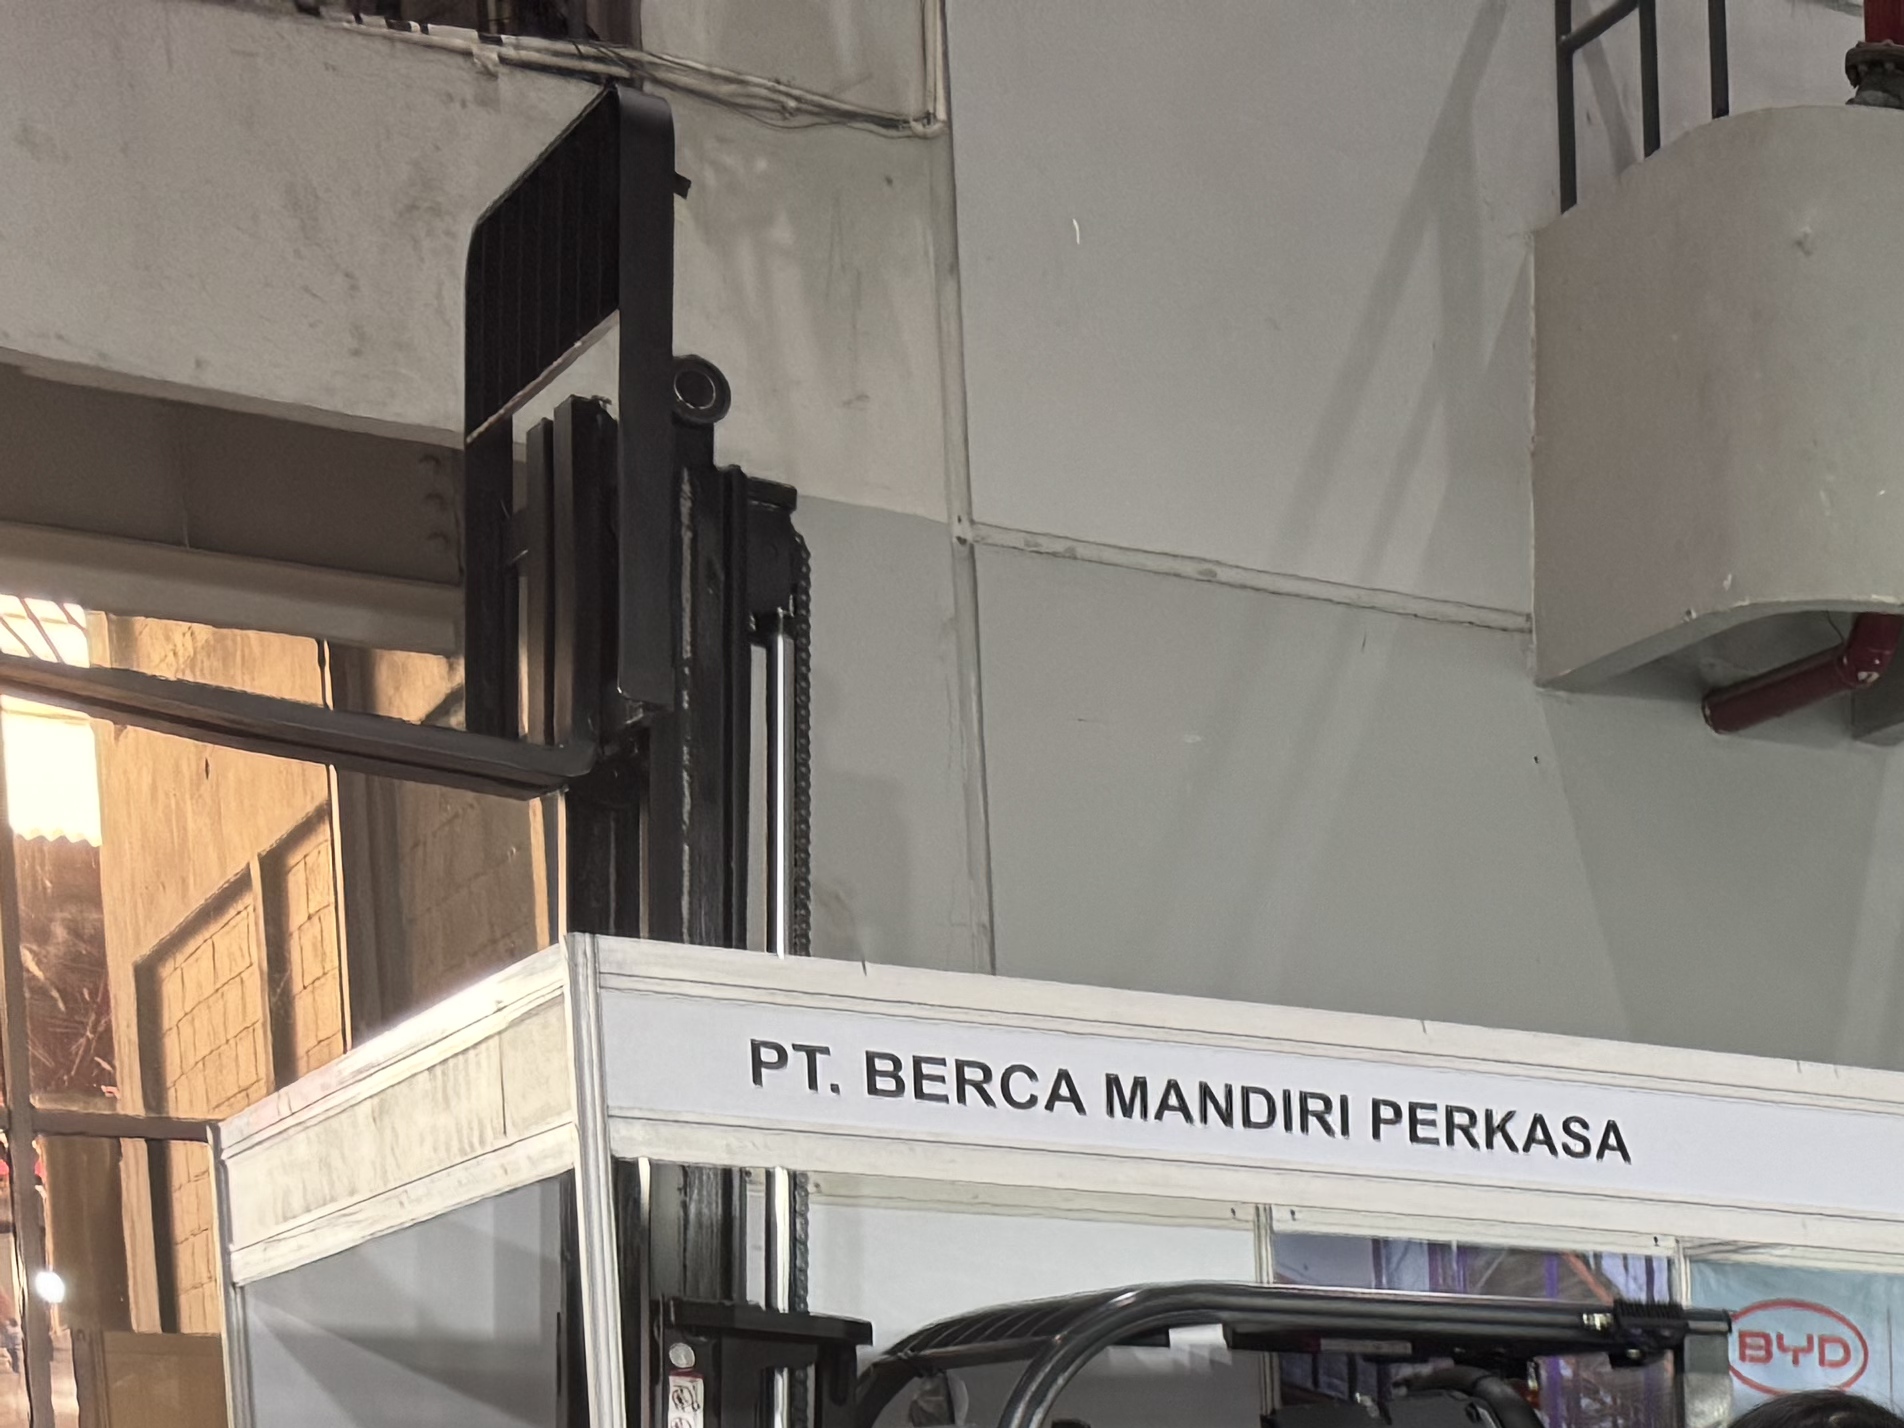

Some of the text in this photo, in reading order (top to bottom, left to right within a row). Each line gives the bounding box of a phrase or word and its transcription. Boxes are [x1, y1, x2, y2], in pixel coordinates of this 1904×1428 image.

[749, 1039, 1633, 1165] PT. BERCA MANDIRI PERKASA
[1738, 1331, 1851, 1369] BYD
